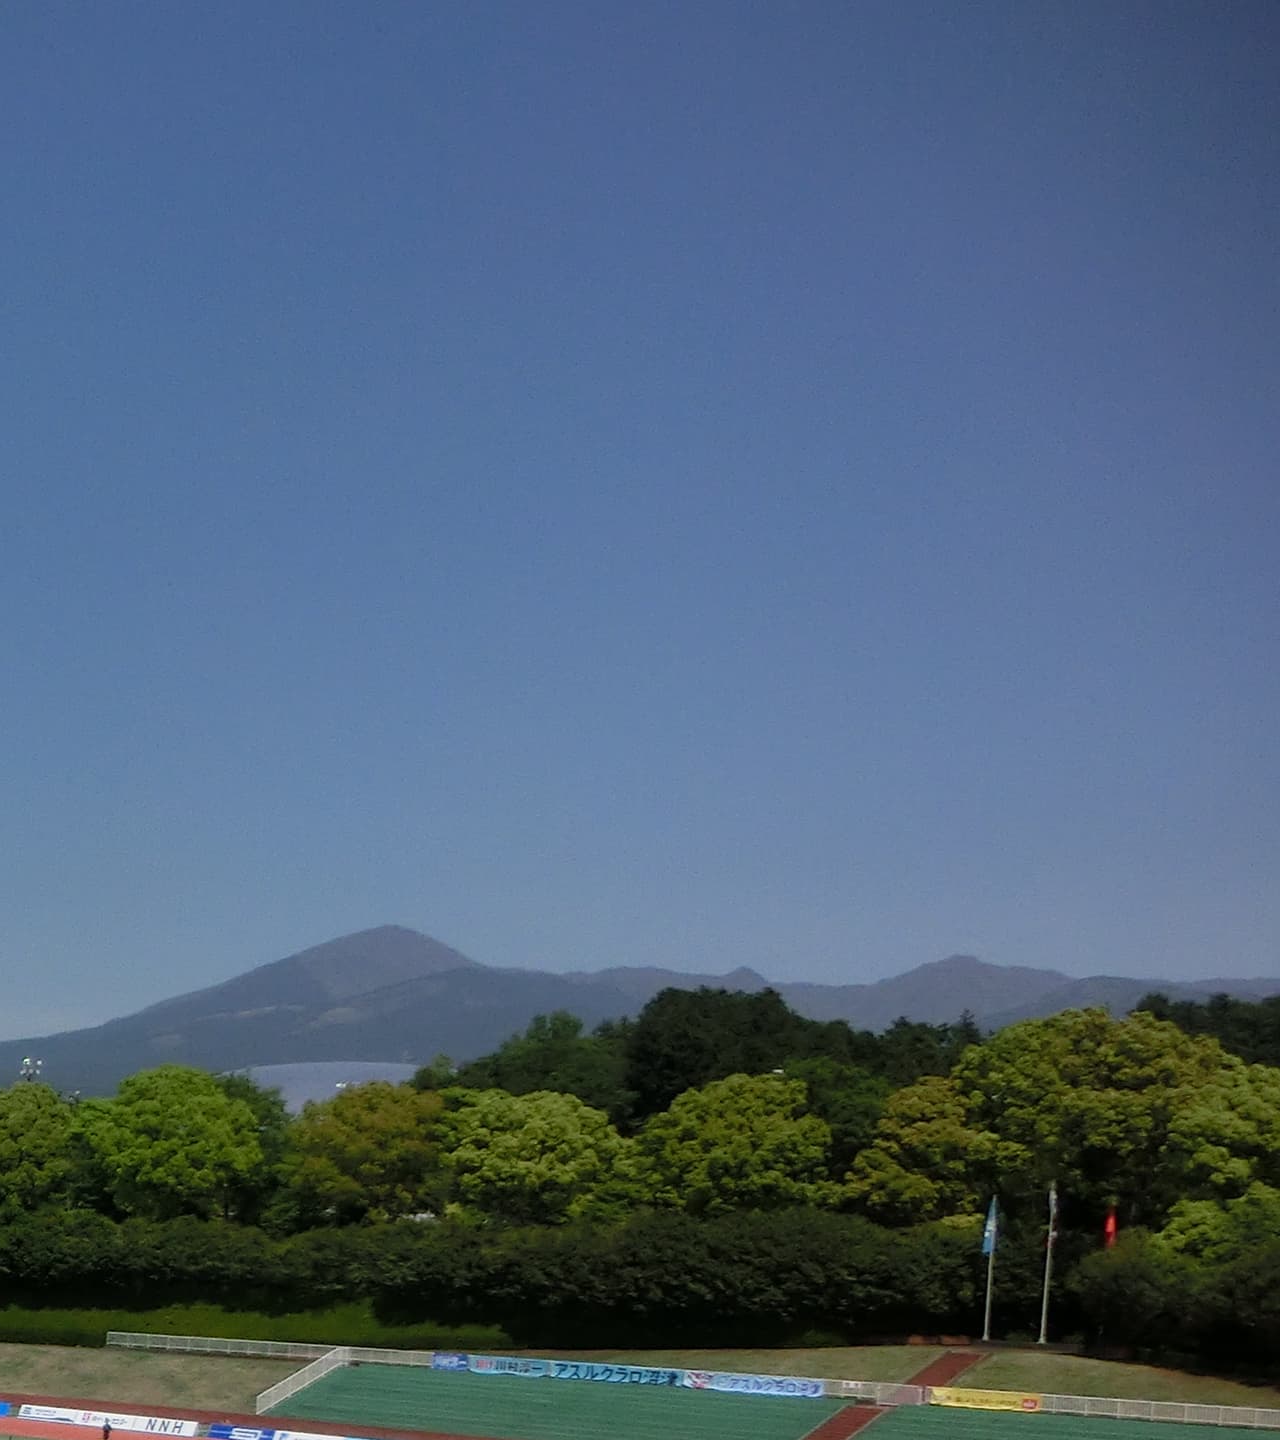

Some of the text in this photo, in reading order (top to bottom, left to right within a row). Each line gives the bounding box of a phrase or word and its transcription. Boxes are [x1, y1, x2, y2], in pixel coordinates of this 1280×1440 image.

[554, 1362, 679, 1386] アスルクラロ沼津
[145, 1418, 184, 1434] NNH
